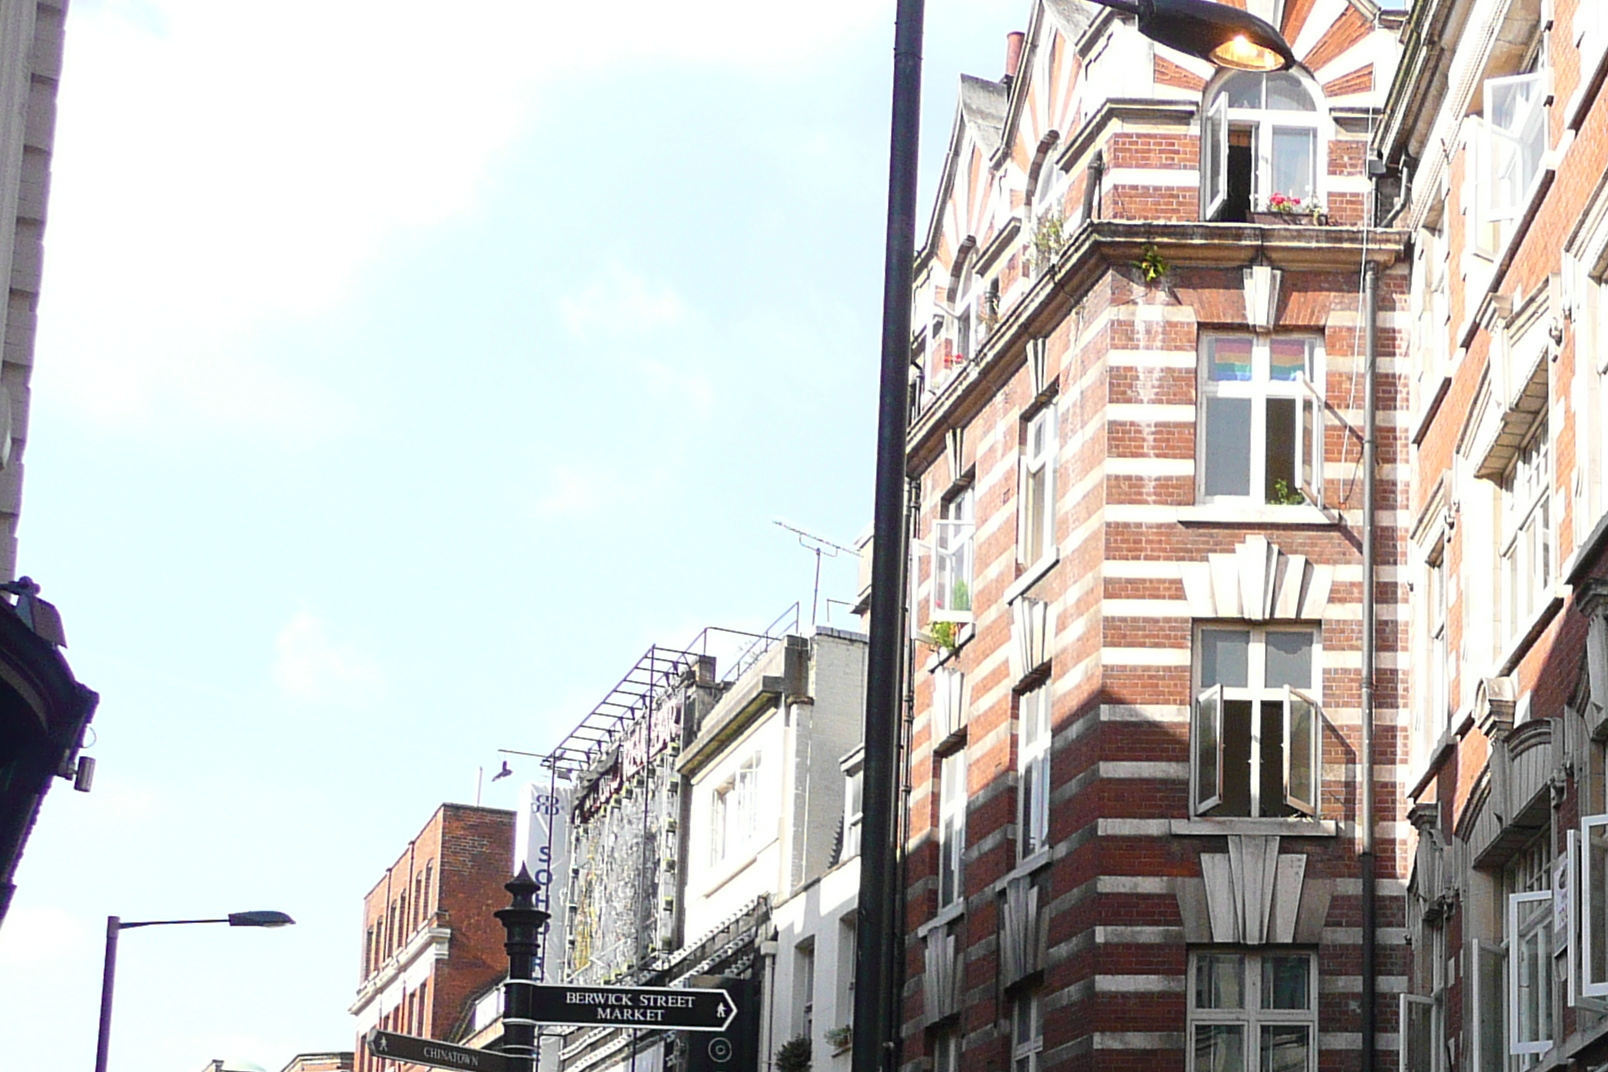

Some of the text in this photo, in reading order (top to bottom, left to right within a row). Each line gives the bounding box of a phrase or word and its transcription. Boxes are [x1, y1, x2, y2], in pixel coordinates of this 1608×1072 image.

[566, 992, 696, 1008] BERWICK STREET
[597, 1007, 665, 1021] MARKET
[423, 1046, 479, 1067] CHINATOWN
